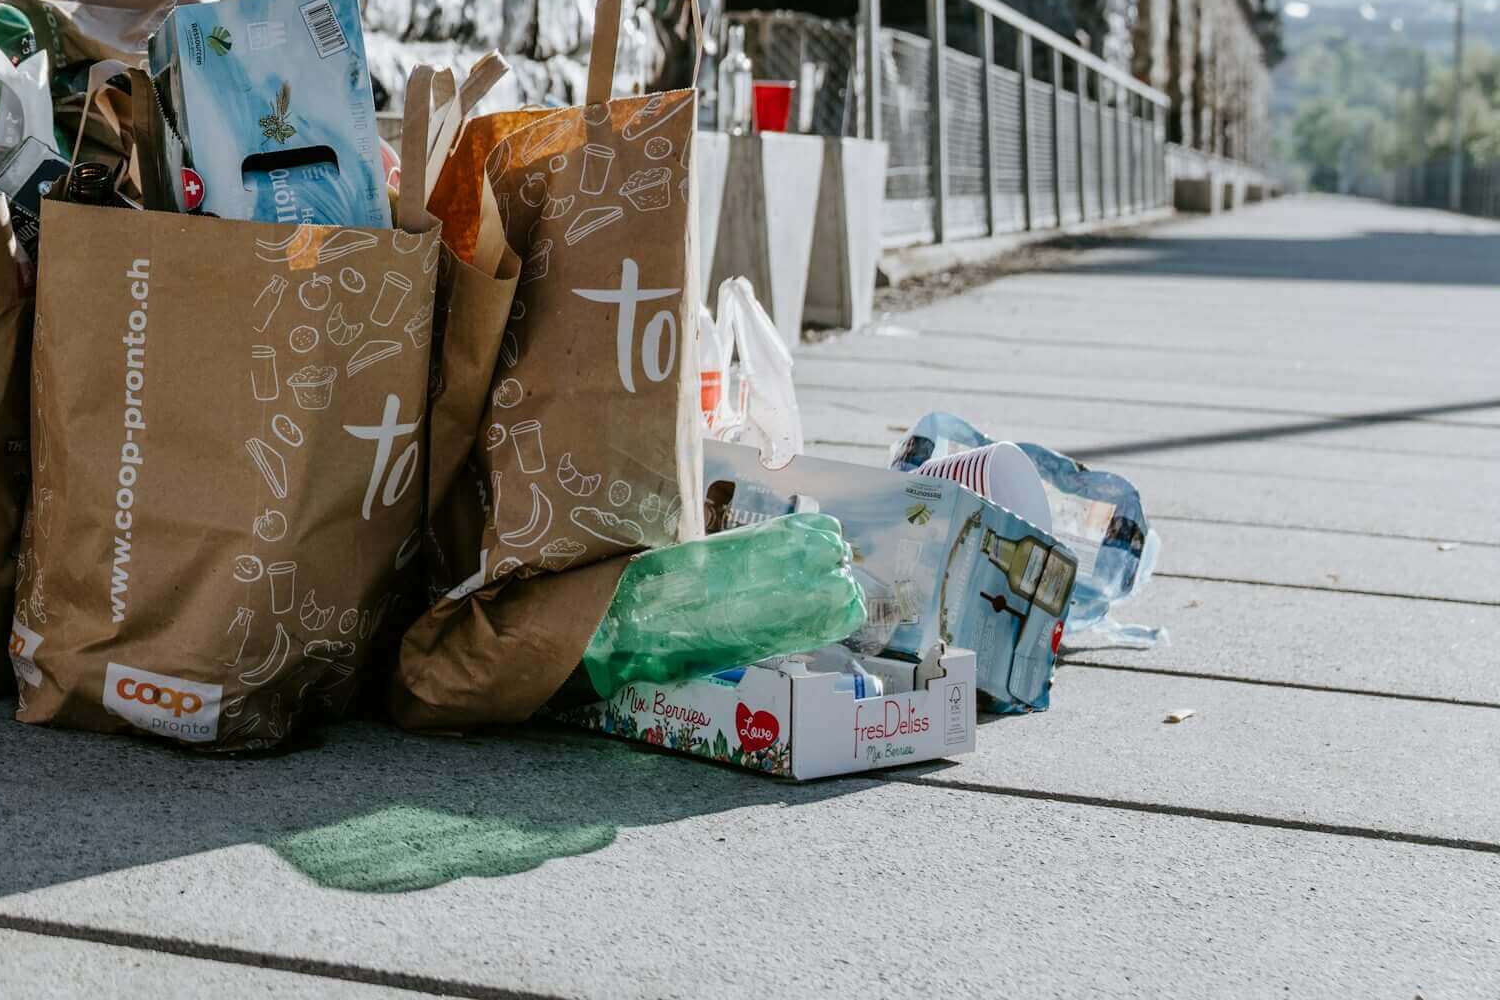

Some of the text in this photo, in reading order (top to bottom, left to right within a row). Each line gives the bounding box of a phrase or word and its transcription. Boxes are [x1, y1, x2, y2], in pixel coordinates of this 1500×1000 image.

[191, 23, 202, 66] Ressourcen
[571, 257, 682, 394] to
[110, 258, 151, 624] www.coop-pronto.ch
[342, 394, 423, 521] to
[115, 676, 203, 718] coop
[651, 689, 712, 728] Berries
[151, 716, 211, 735] pronto
[740, 717, 774, 741] Love
[853, 700, 931, 760] fresDeliss
